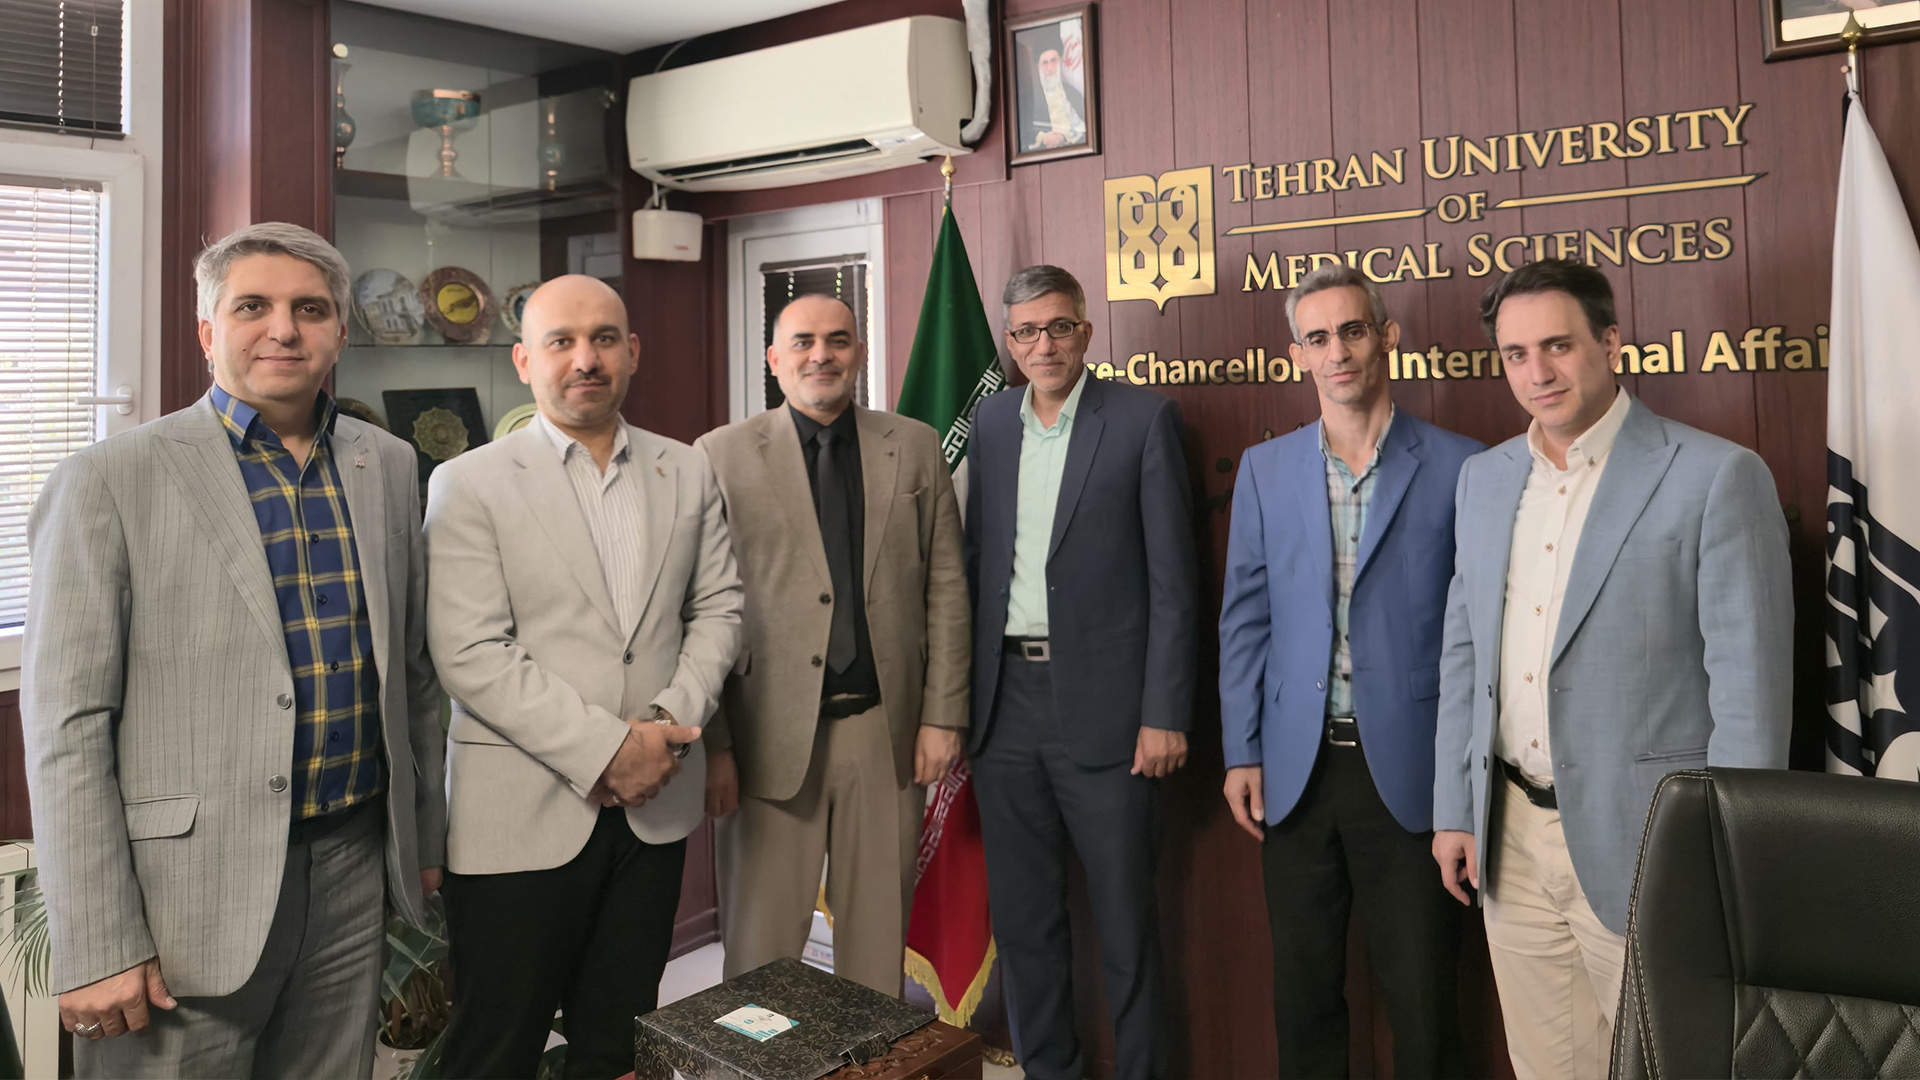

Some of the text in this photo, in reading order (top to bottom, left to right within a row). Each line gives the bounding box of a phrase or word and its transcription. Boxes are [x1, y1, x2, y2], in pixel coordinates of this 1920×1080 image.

[1222, 104, 1753, 203] TEHRAN UNIVERSITY
[1437, 191, 1488, 224] OF
[1467, 217, 1734, 277] SCIENCES
[1086, 325, 1829, 386] e-Chancello Internal Affai
